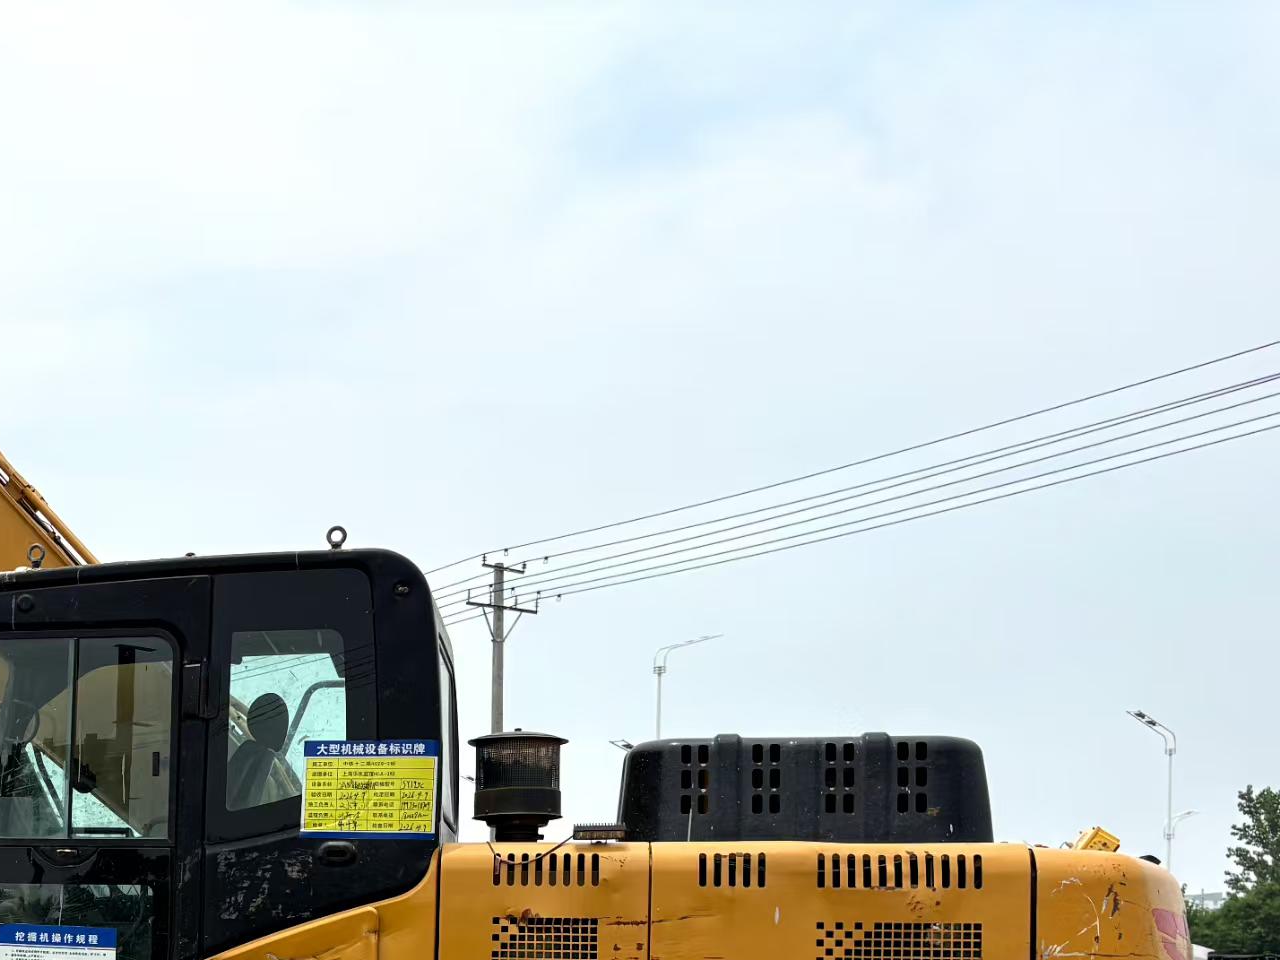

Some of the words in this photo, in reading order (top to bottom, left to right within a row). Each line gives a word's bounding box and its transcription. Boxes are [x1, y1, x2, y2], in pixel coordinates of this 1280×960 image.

[316, 743, 426, 755] 大型机械设备标识牌
[14, 931, 99, 945] 挖掘机操作规程
